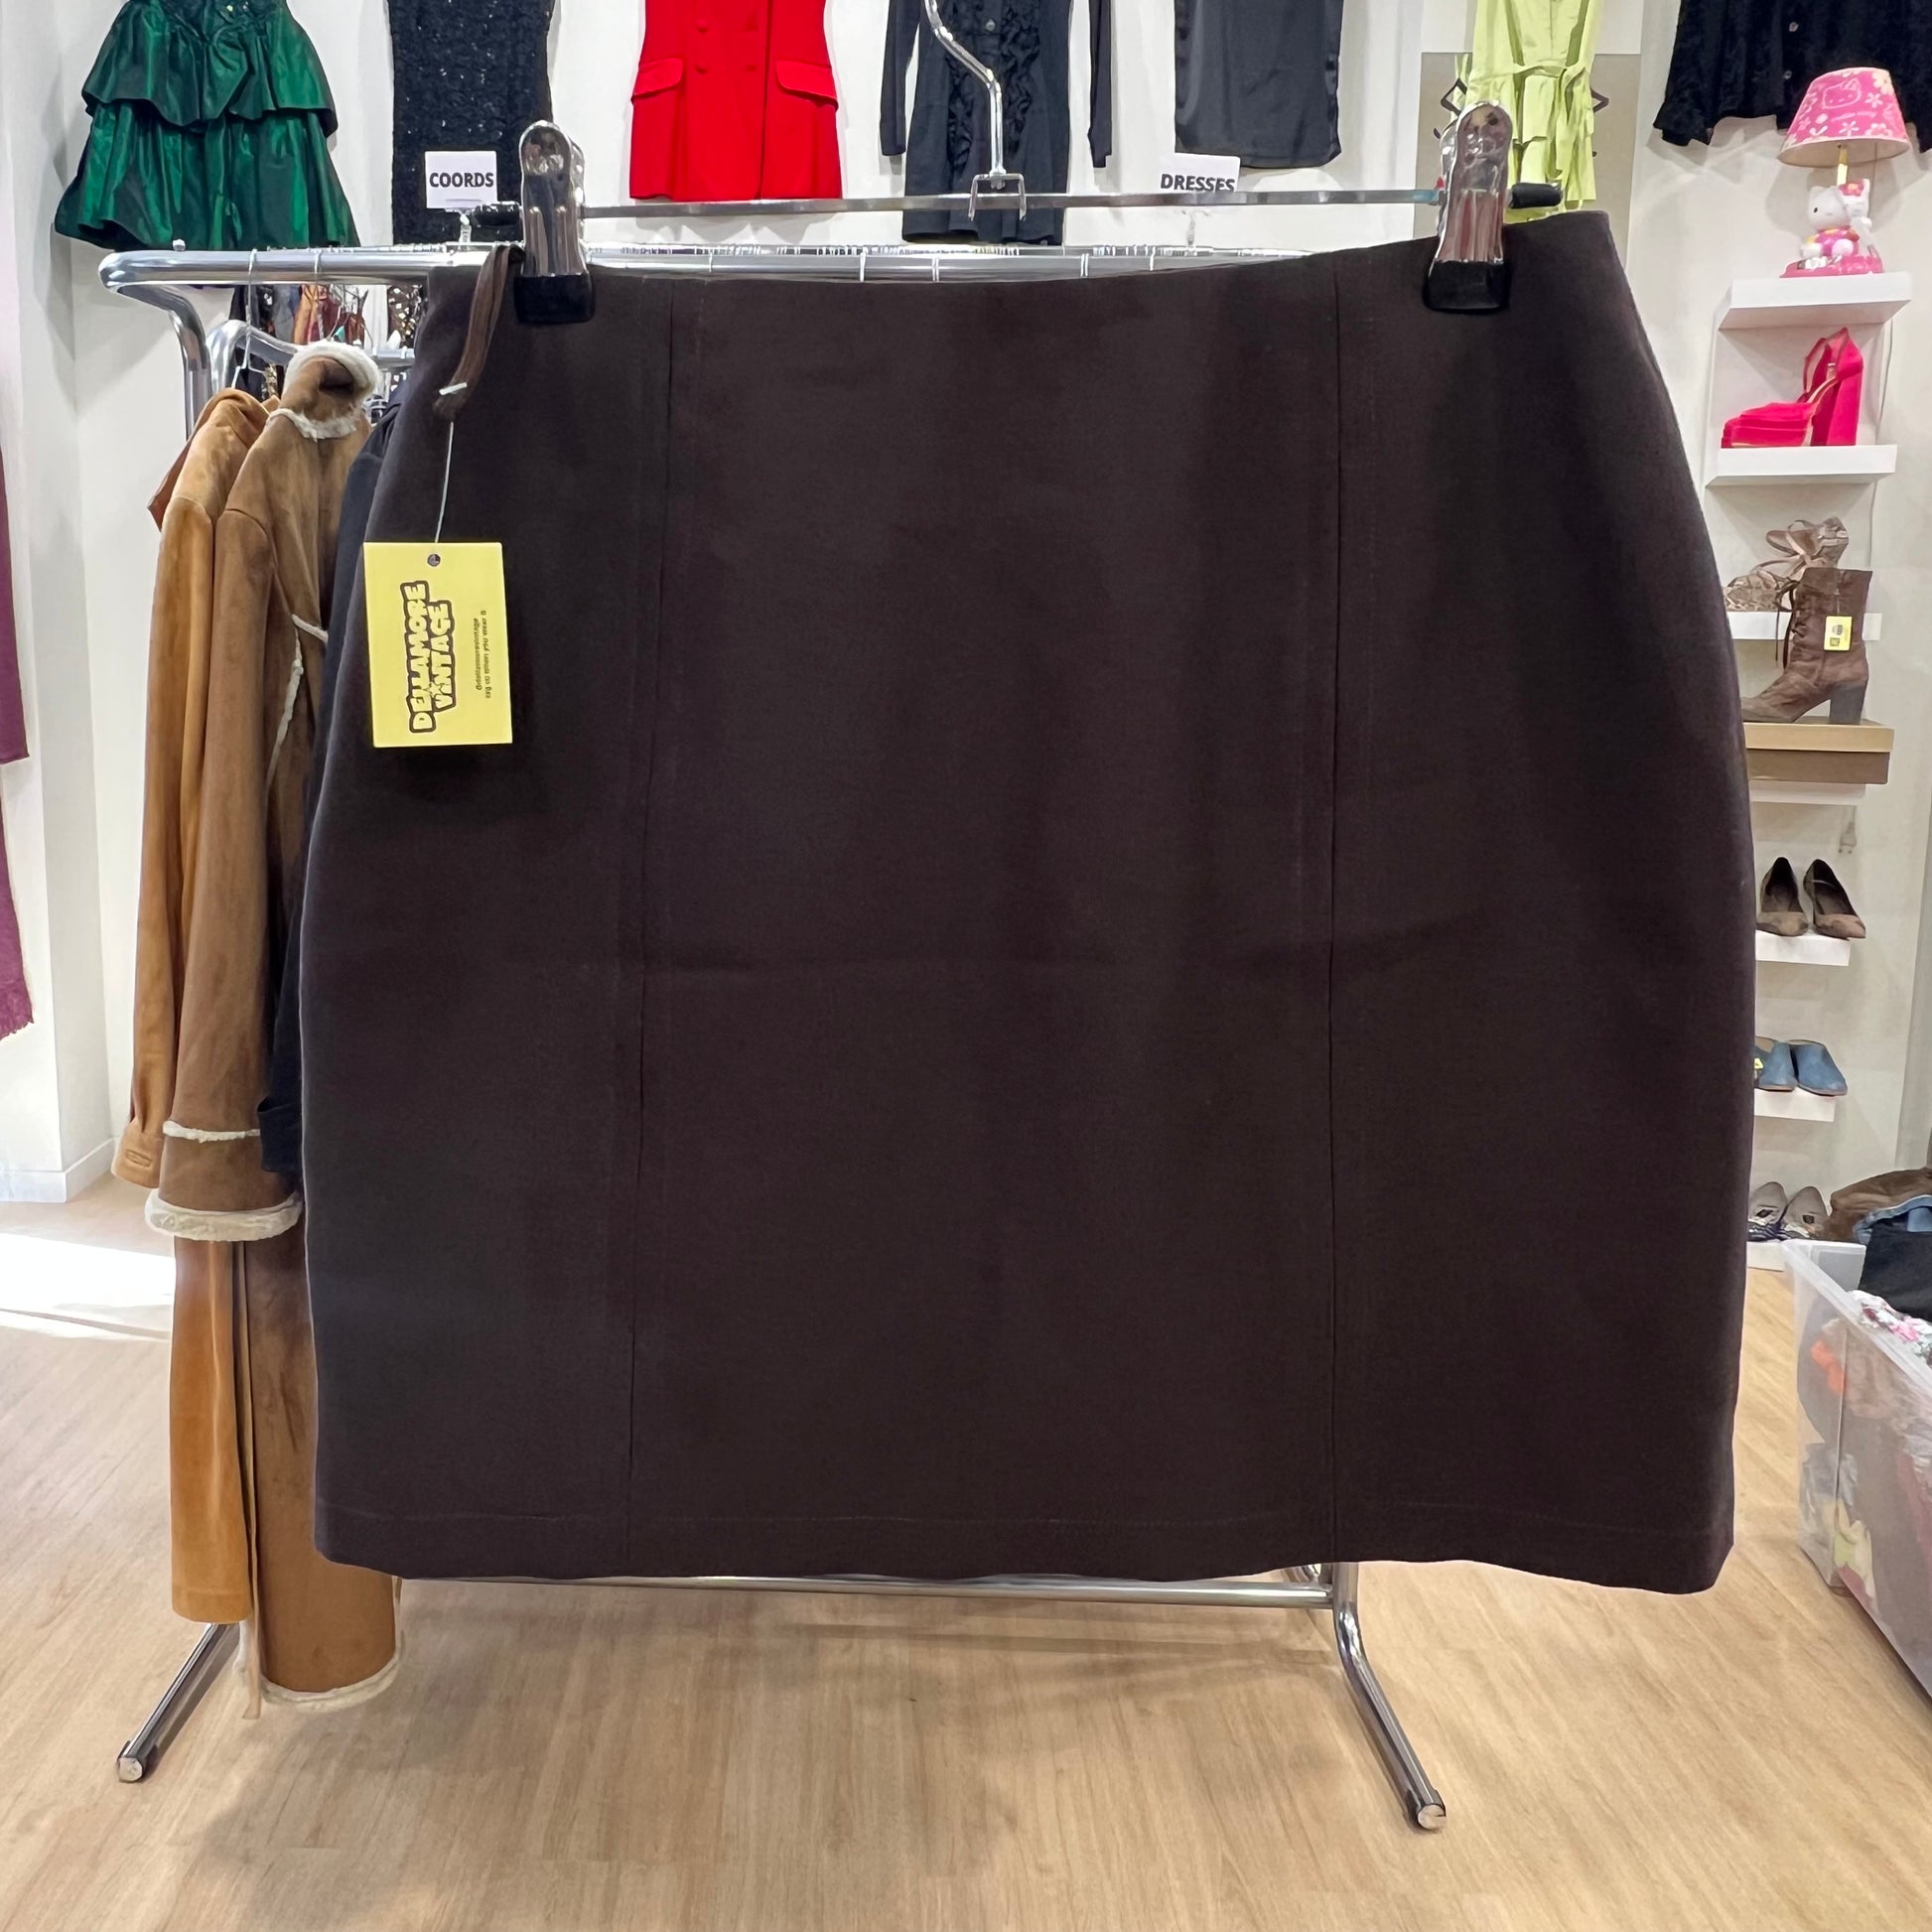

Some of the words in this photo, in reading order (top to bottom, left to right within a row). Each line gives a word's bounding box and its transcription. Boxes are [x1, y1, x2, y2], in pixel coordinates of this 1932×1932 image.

[430, 172, 494, 188] COORDS
[1161, 174, 1235, 192] DRESSES
[401, 581, 435, 733] DELLAMORE
[427, 601, 456, 712] VINTAGE
